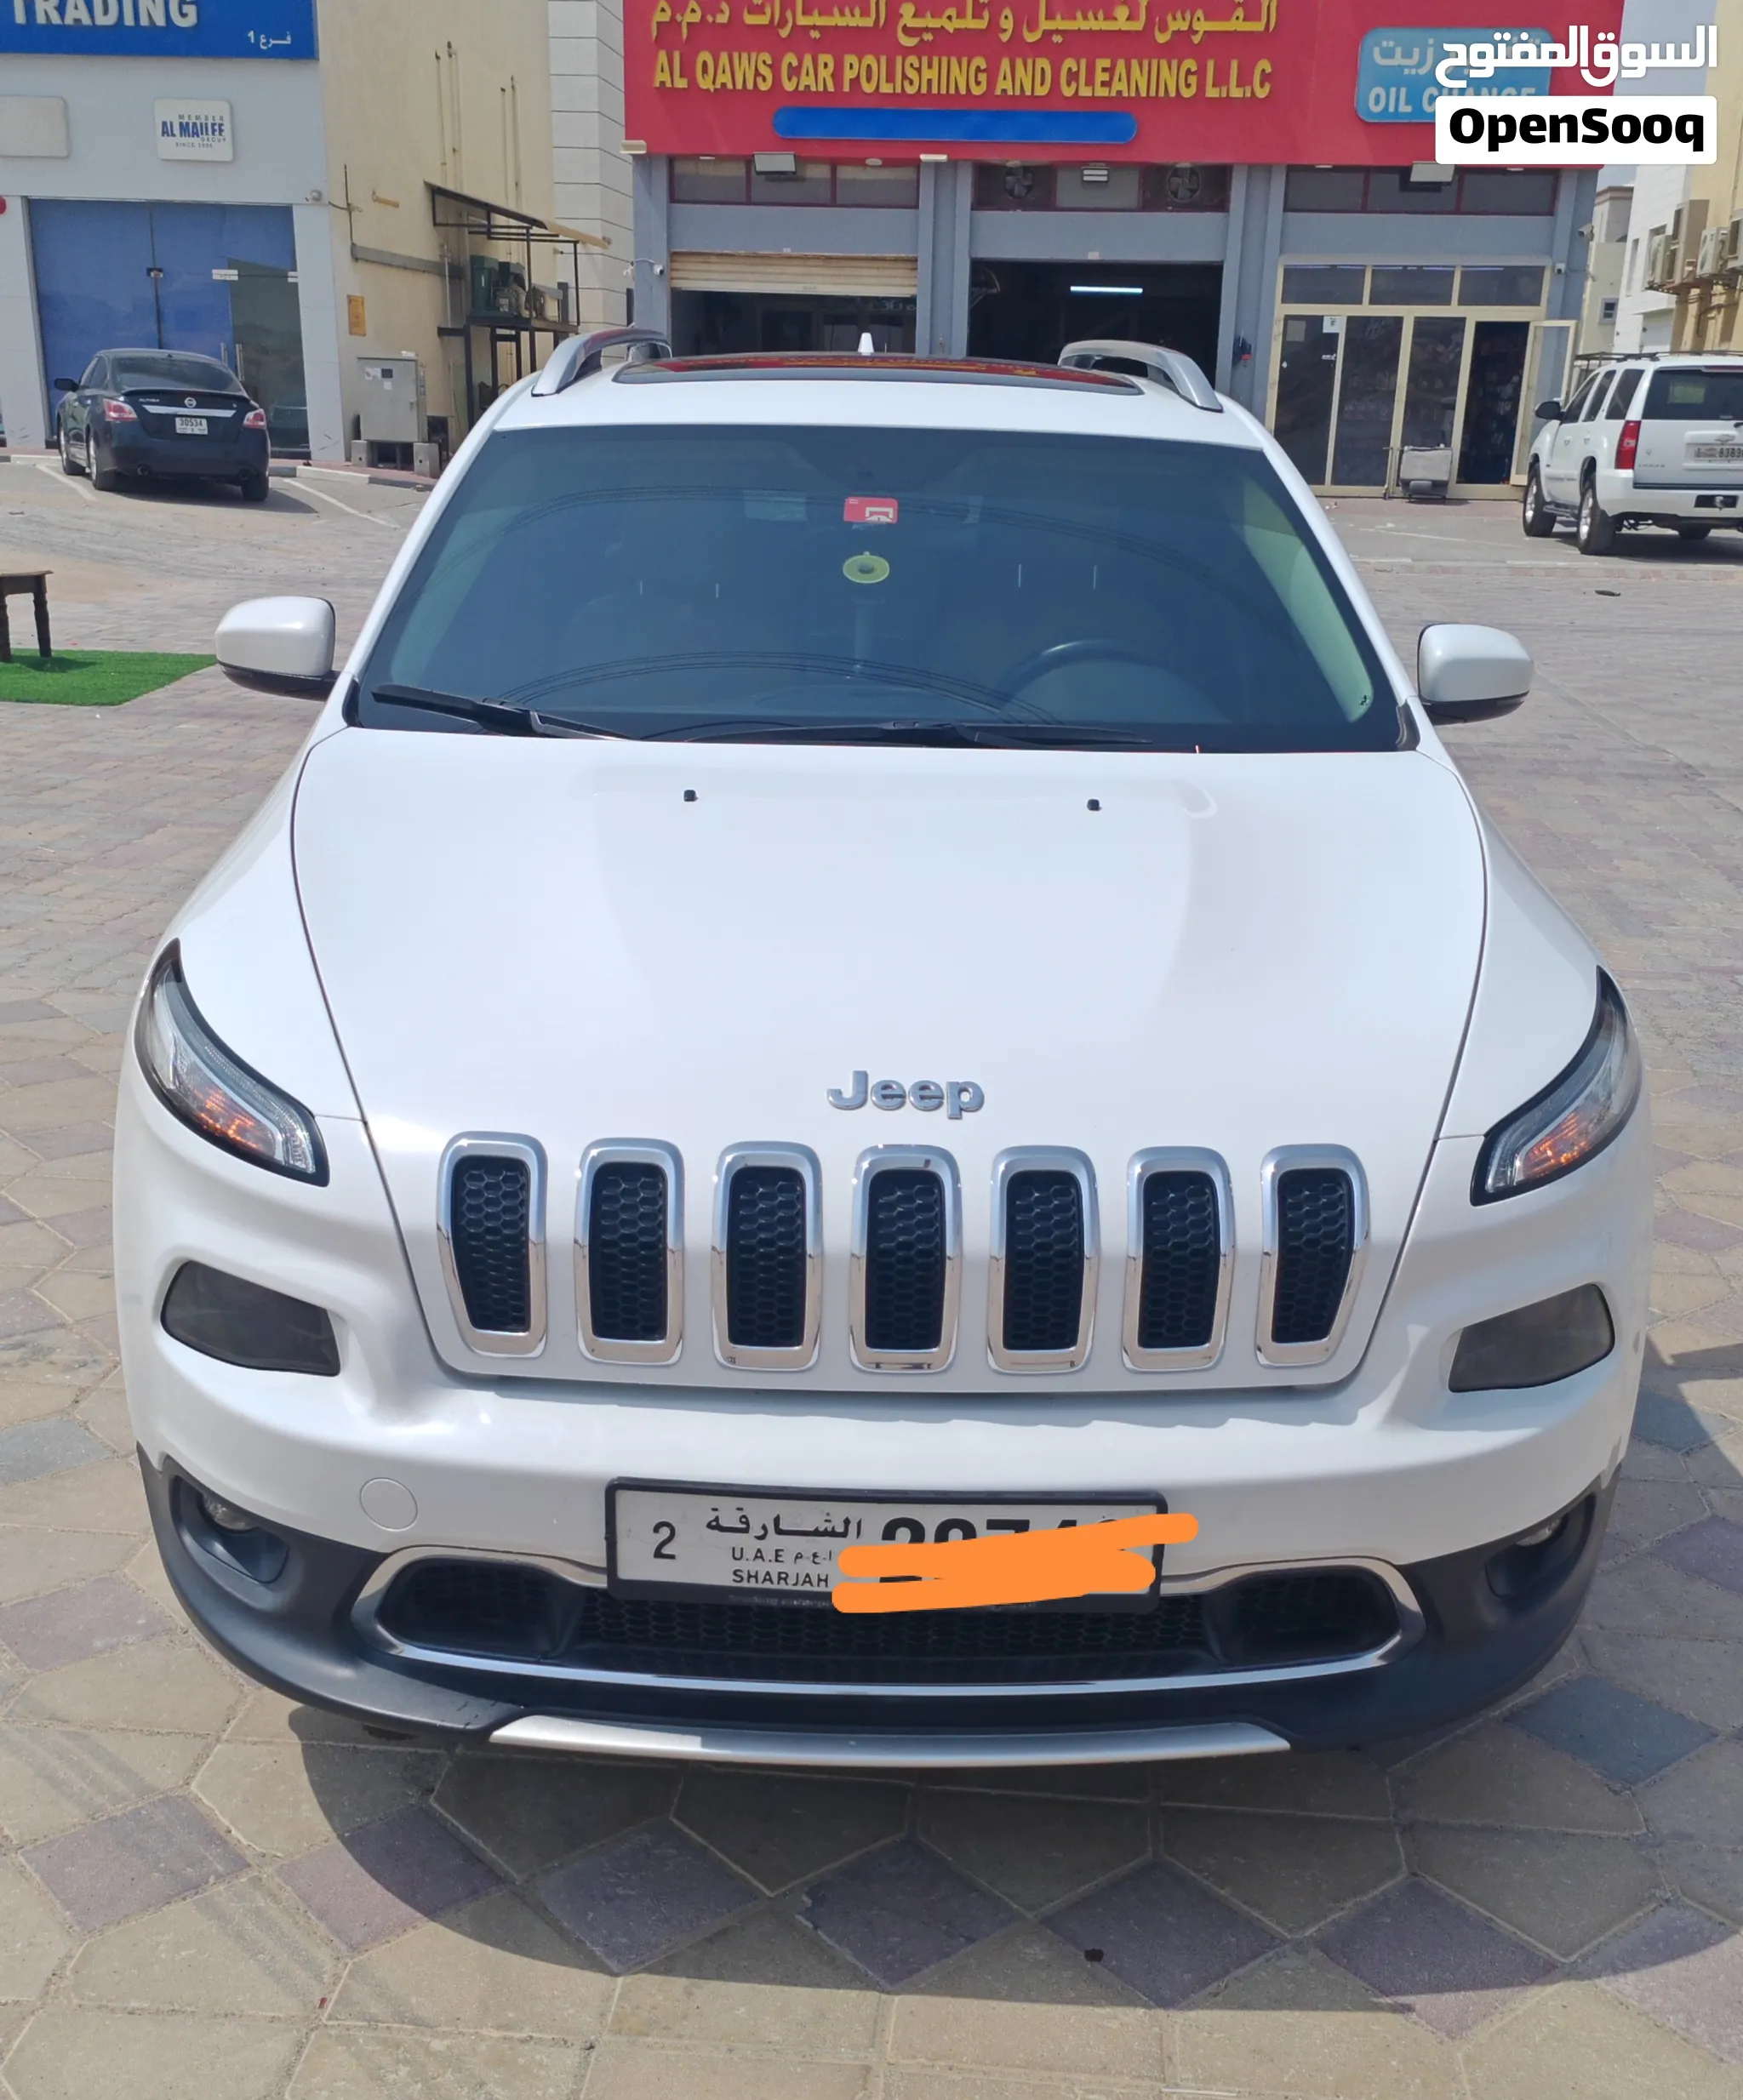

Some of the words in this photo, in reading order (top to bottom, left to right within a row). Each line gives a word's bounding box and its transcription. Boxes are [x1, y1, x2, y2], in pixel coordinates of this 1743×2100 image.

[13, 0, 198, 27] TRADING
[998, 5, 1014, 43] و
[248, 31, 255, 43] 1
[260, 31, 292, 49] فرع
[1373, 38, 1434, 75] زيت
[654, 49, 688, 88] AL
[695, 51, 773, 92] QAWS
[781, 53, 835, 92] CAR
[843, 54, 987, 95] POLISHING
[994, 57, 1052, 96] AND
[1060, 58, 1197, 98] CLEANING
[1204, 59, 1272, 99] L.L.C
[1368, 87, 1413, 113] OIL
[161, 121, 176, 137] AL
[826, 1070, 985, 1120] Jeep
[706, 1507, 862, 1541] الشارقة
[653, 1521, 676, 1560] 2
[731, 1546, 785, 1564] U.A.E
[732, 1568, 829, 1588] SHARJAH
